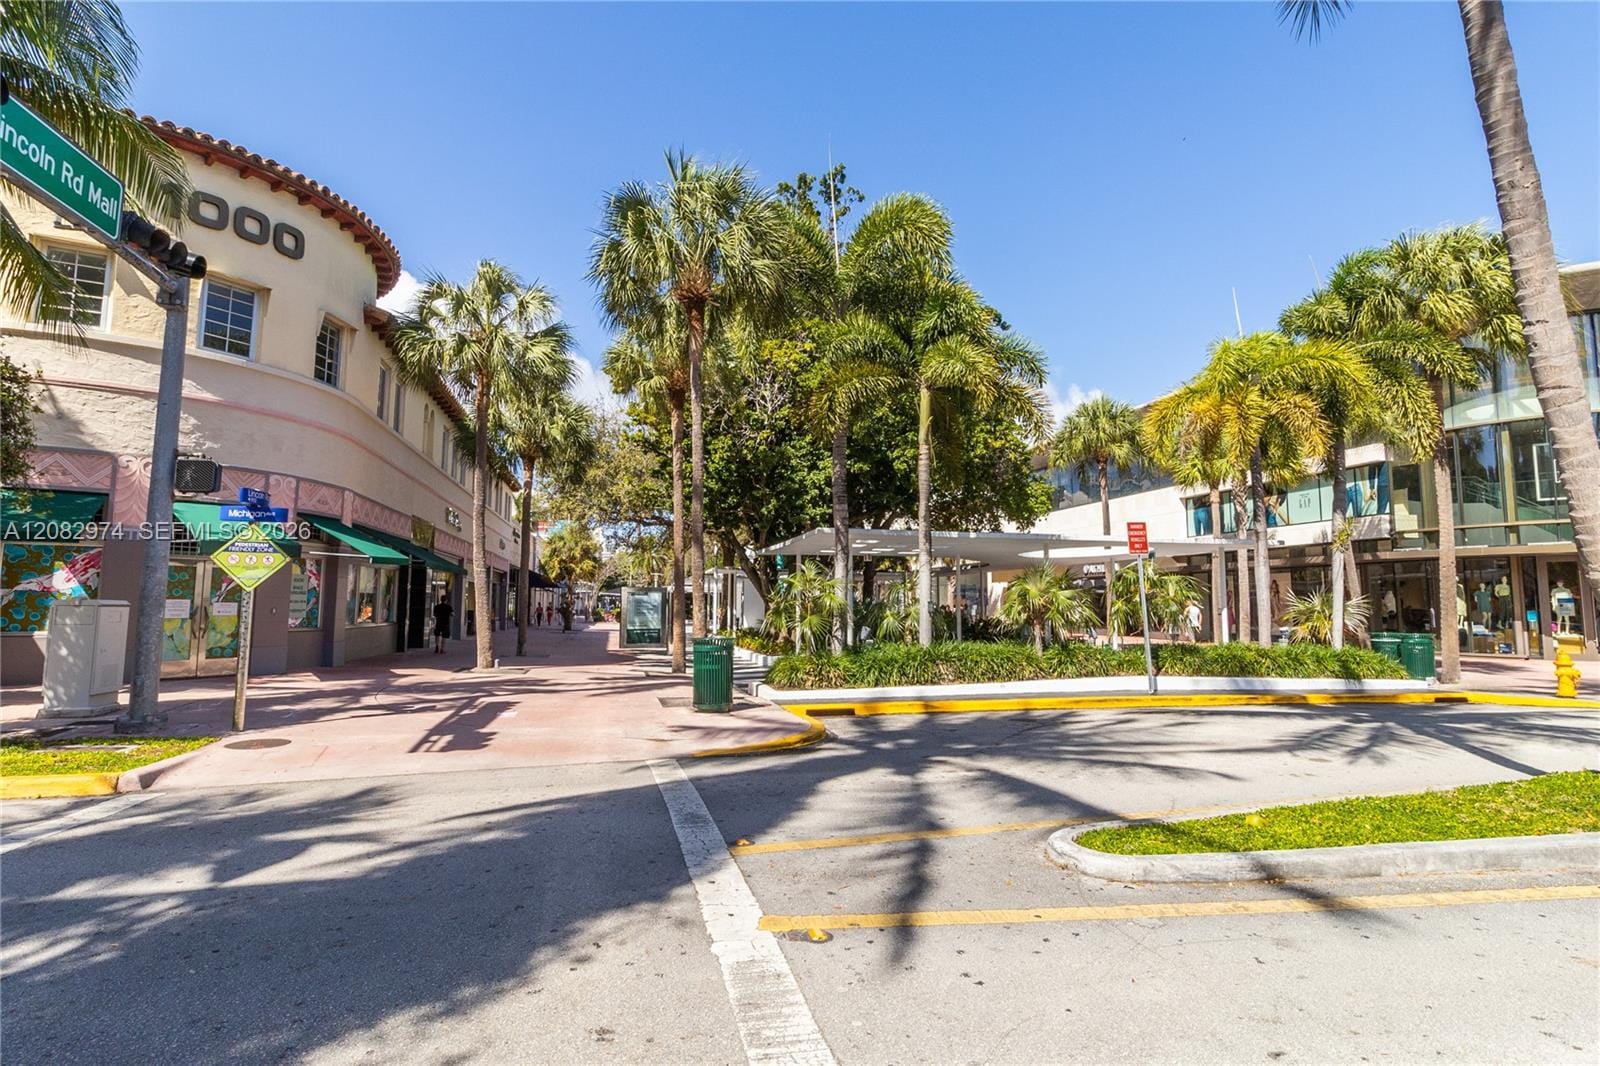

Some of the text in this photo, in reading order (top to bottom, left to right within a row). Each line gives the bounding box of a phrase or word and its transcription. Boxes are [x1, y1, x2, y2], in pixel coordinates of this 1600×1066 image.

[0, 114, 117, 221] incoln Rd Mall
[228, 509, 265, 519] Michigan
